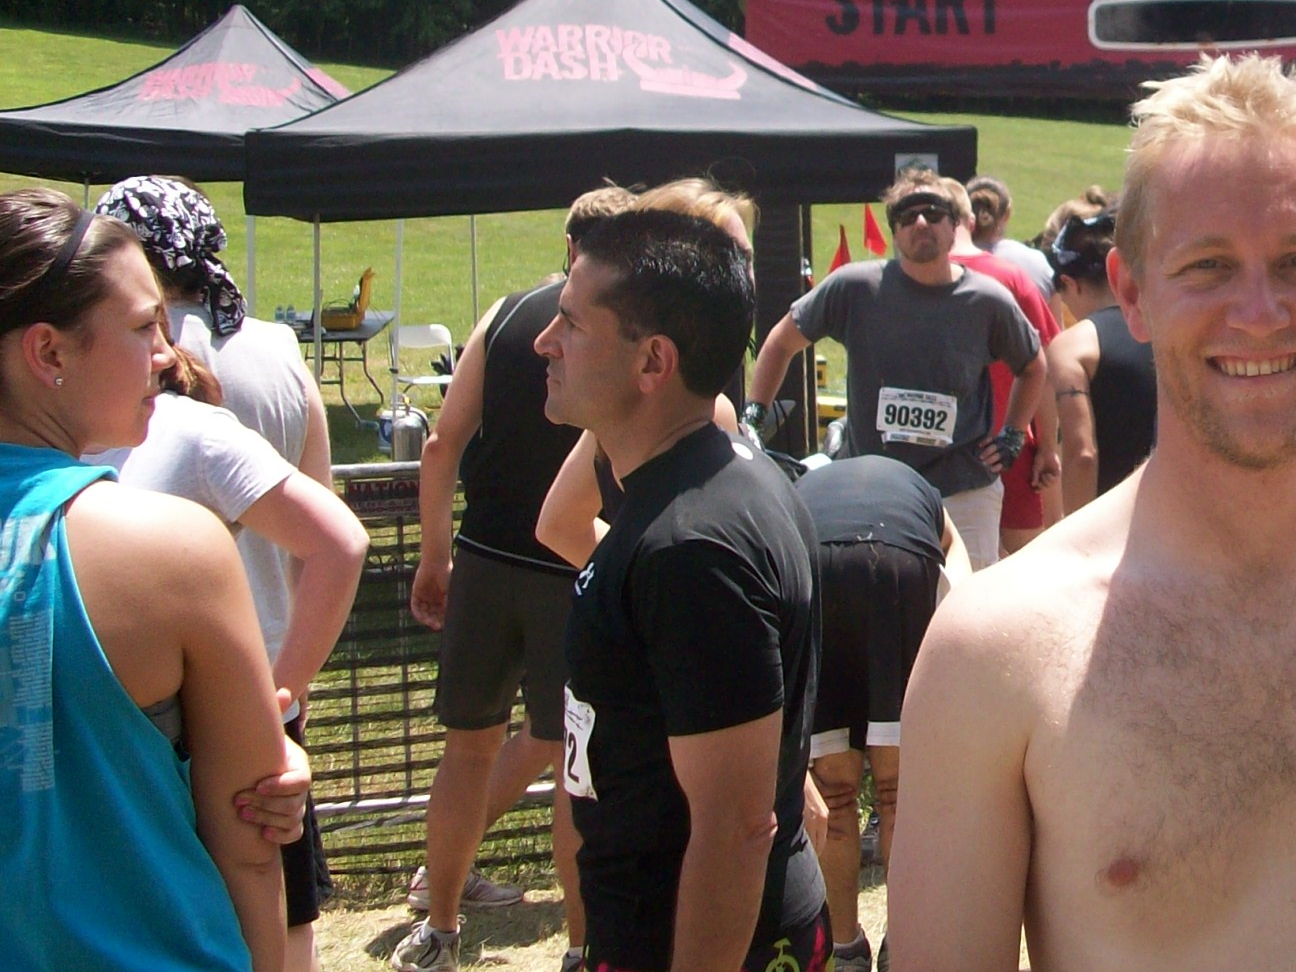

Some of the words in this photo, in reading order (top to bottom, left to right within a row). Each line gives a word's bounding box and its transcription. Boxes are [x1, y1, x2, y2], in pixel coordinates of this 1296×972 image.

[496, 24, 673, 64] WARRIOR
[502, 50, 619, 81] DASH
[885, 404, 947, 431] 90392
